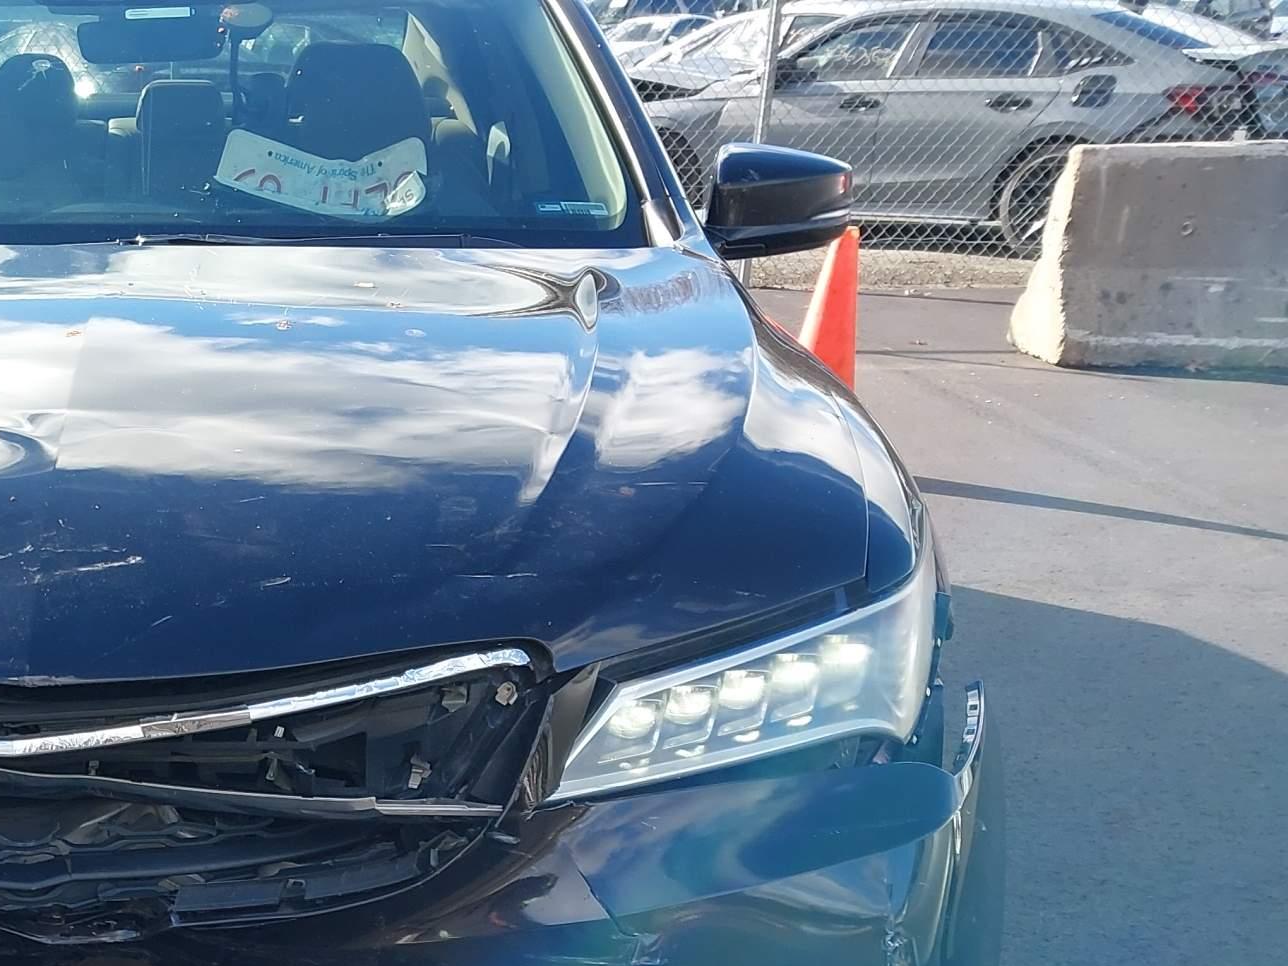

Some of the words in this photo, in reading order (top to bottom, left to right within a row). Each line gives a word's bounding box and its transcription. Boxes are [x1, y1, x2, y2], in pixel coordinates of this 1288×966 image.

[274, 152, 316, 174] America
[316, 165, 328, 177] of
[330, 168, 359, 181] Spirit
